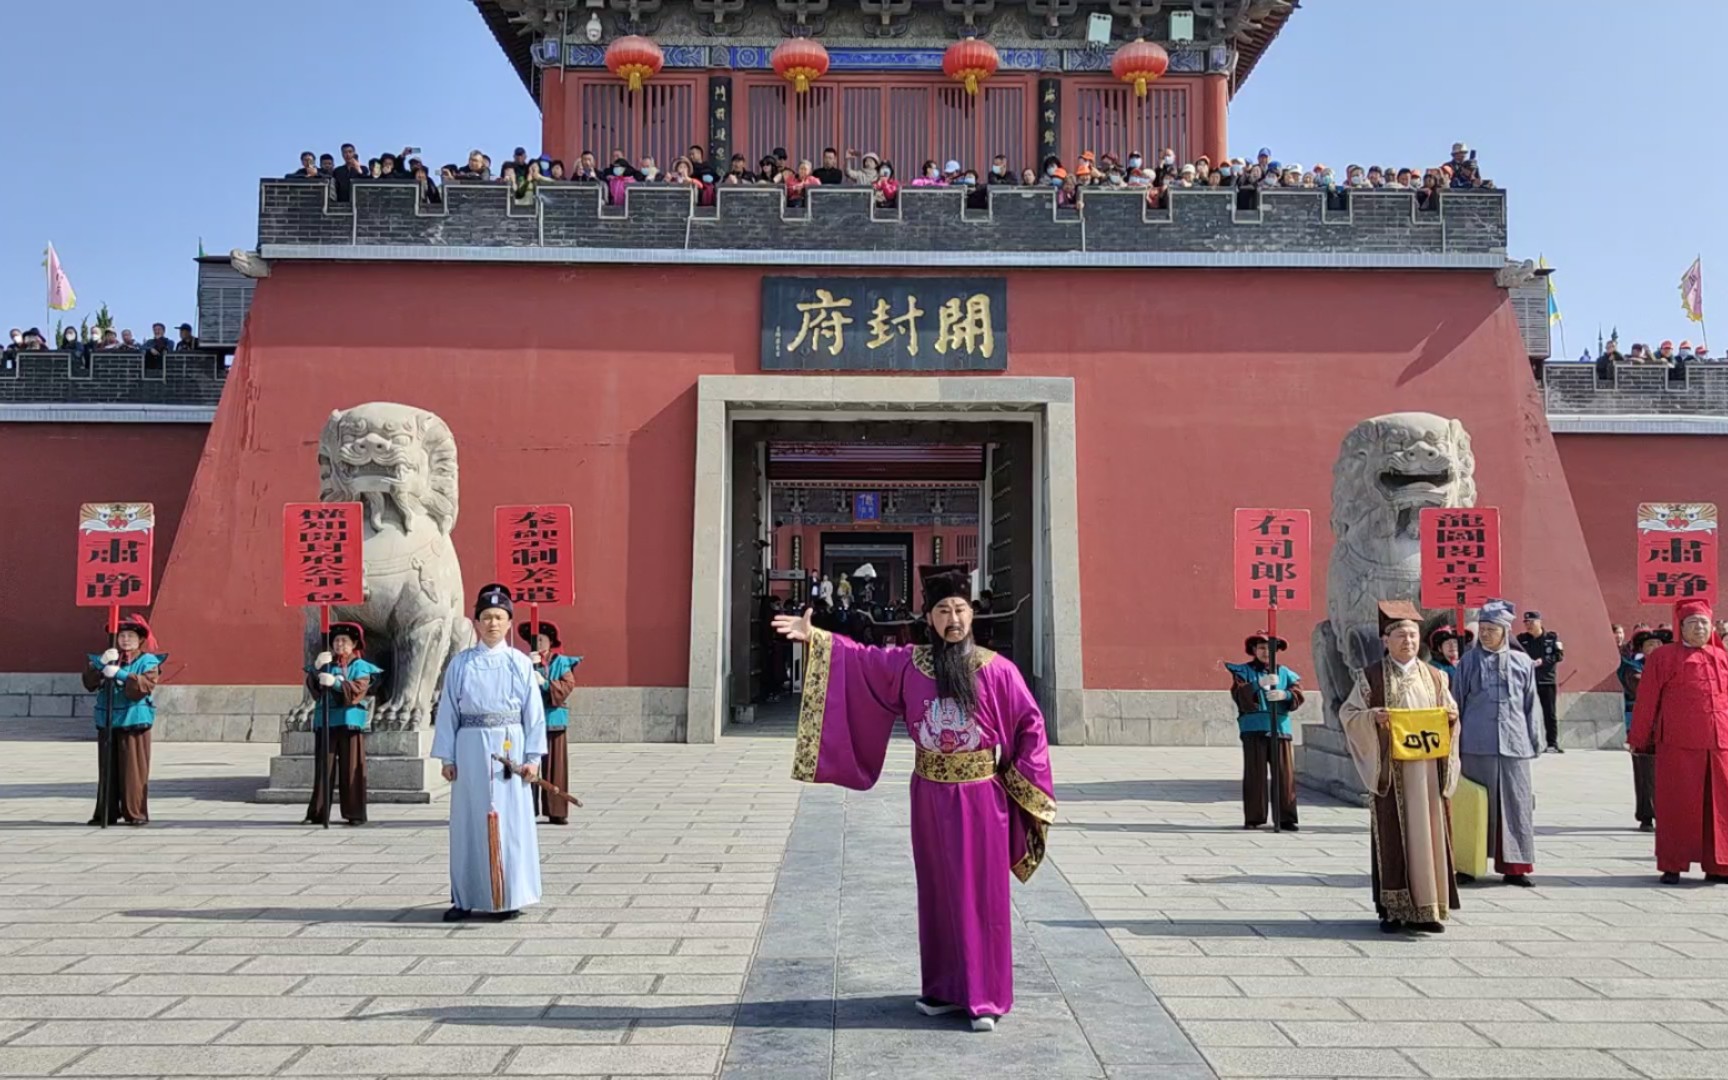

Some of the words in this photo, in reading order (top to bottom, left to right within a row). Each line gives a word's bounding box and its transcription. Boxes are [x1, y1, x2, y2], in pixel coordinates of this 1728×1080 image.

[787, 289, 994, 357] 開封府
[1248, 515, 1297, 606] 右司郎中
